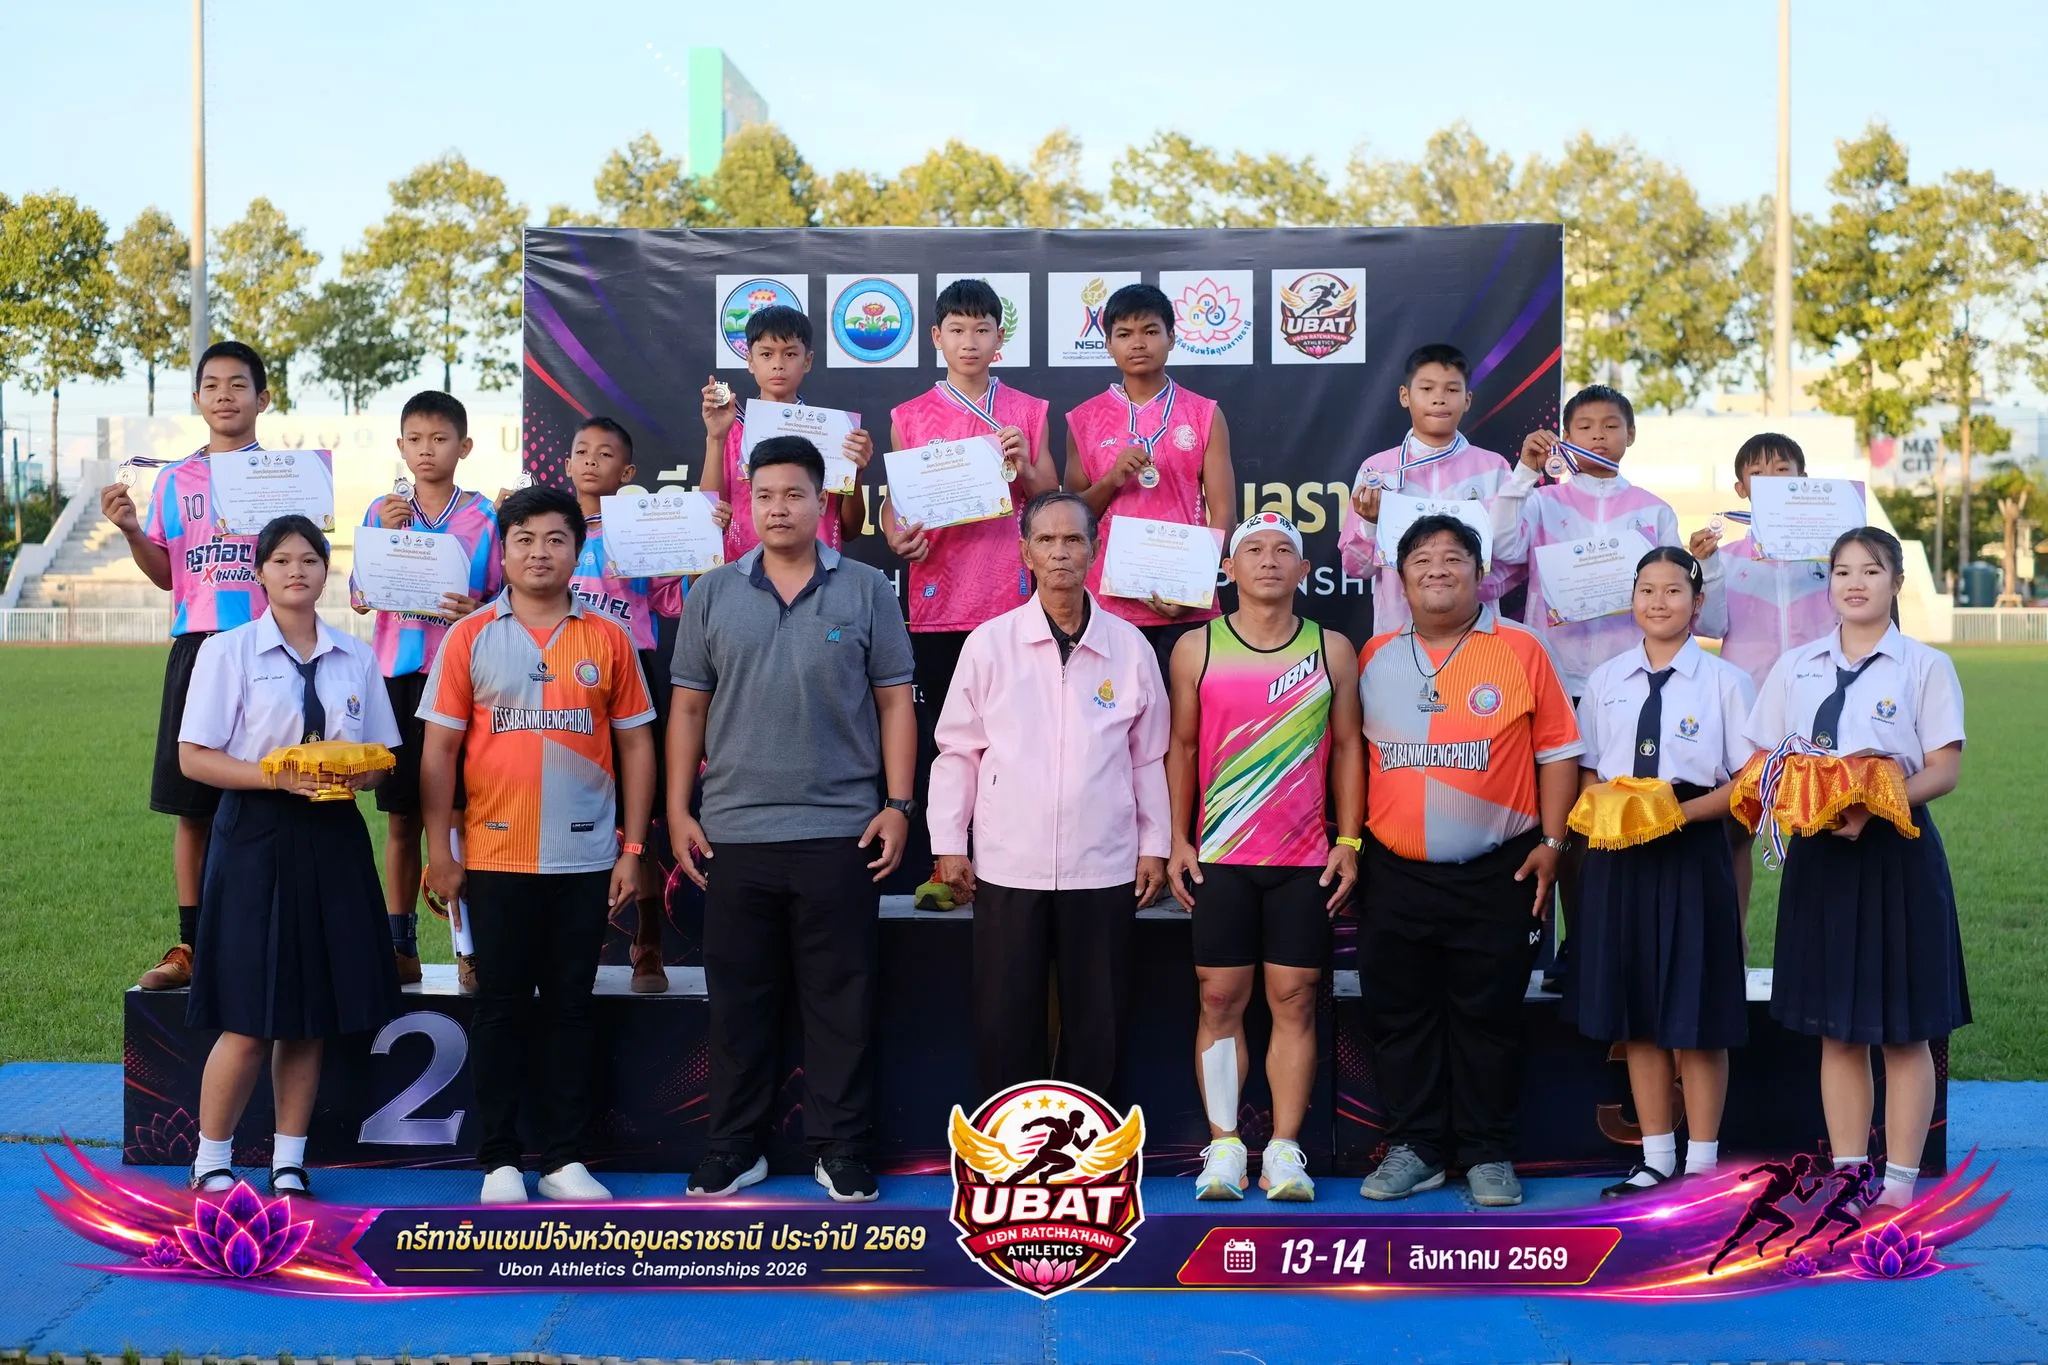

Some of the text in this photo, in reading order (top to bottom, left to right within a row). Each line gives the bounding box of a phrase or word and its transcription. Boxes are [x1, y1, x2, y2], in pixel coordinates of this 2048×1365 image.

[1286, 317, 1351, 334] UBAT
[1075, 340, 1106, 350] NSD
[183, 493, 205, 522] 10
[1267, 650, 1318, 704] UBN
[357, 1010, 469, 1145] 2
